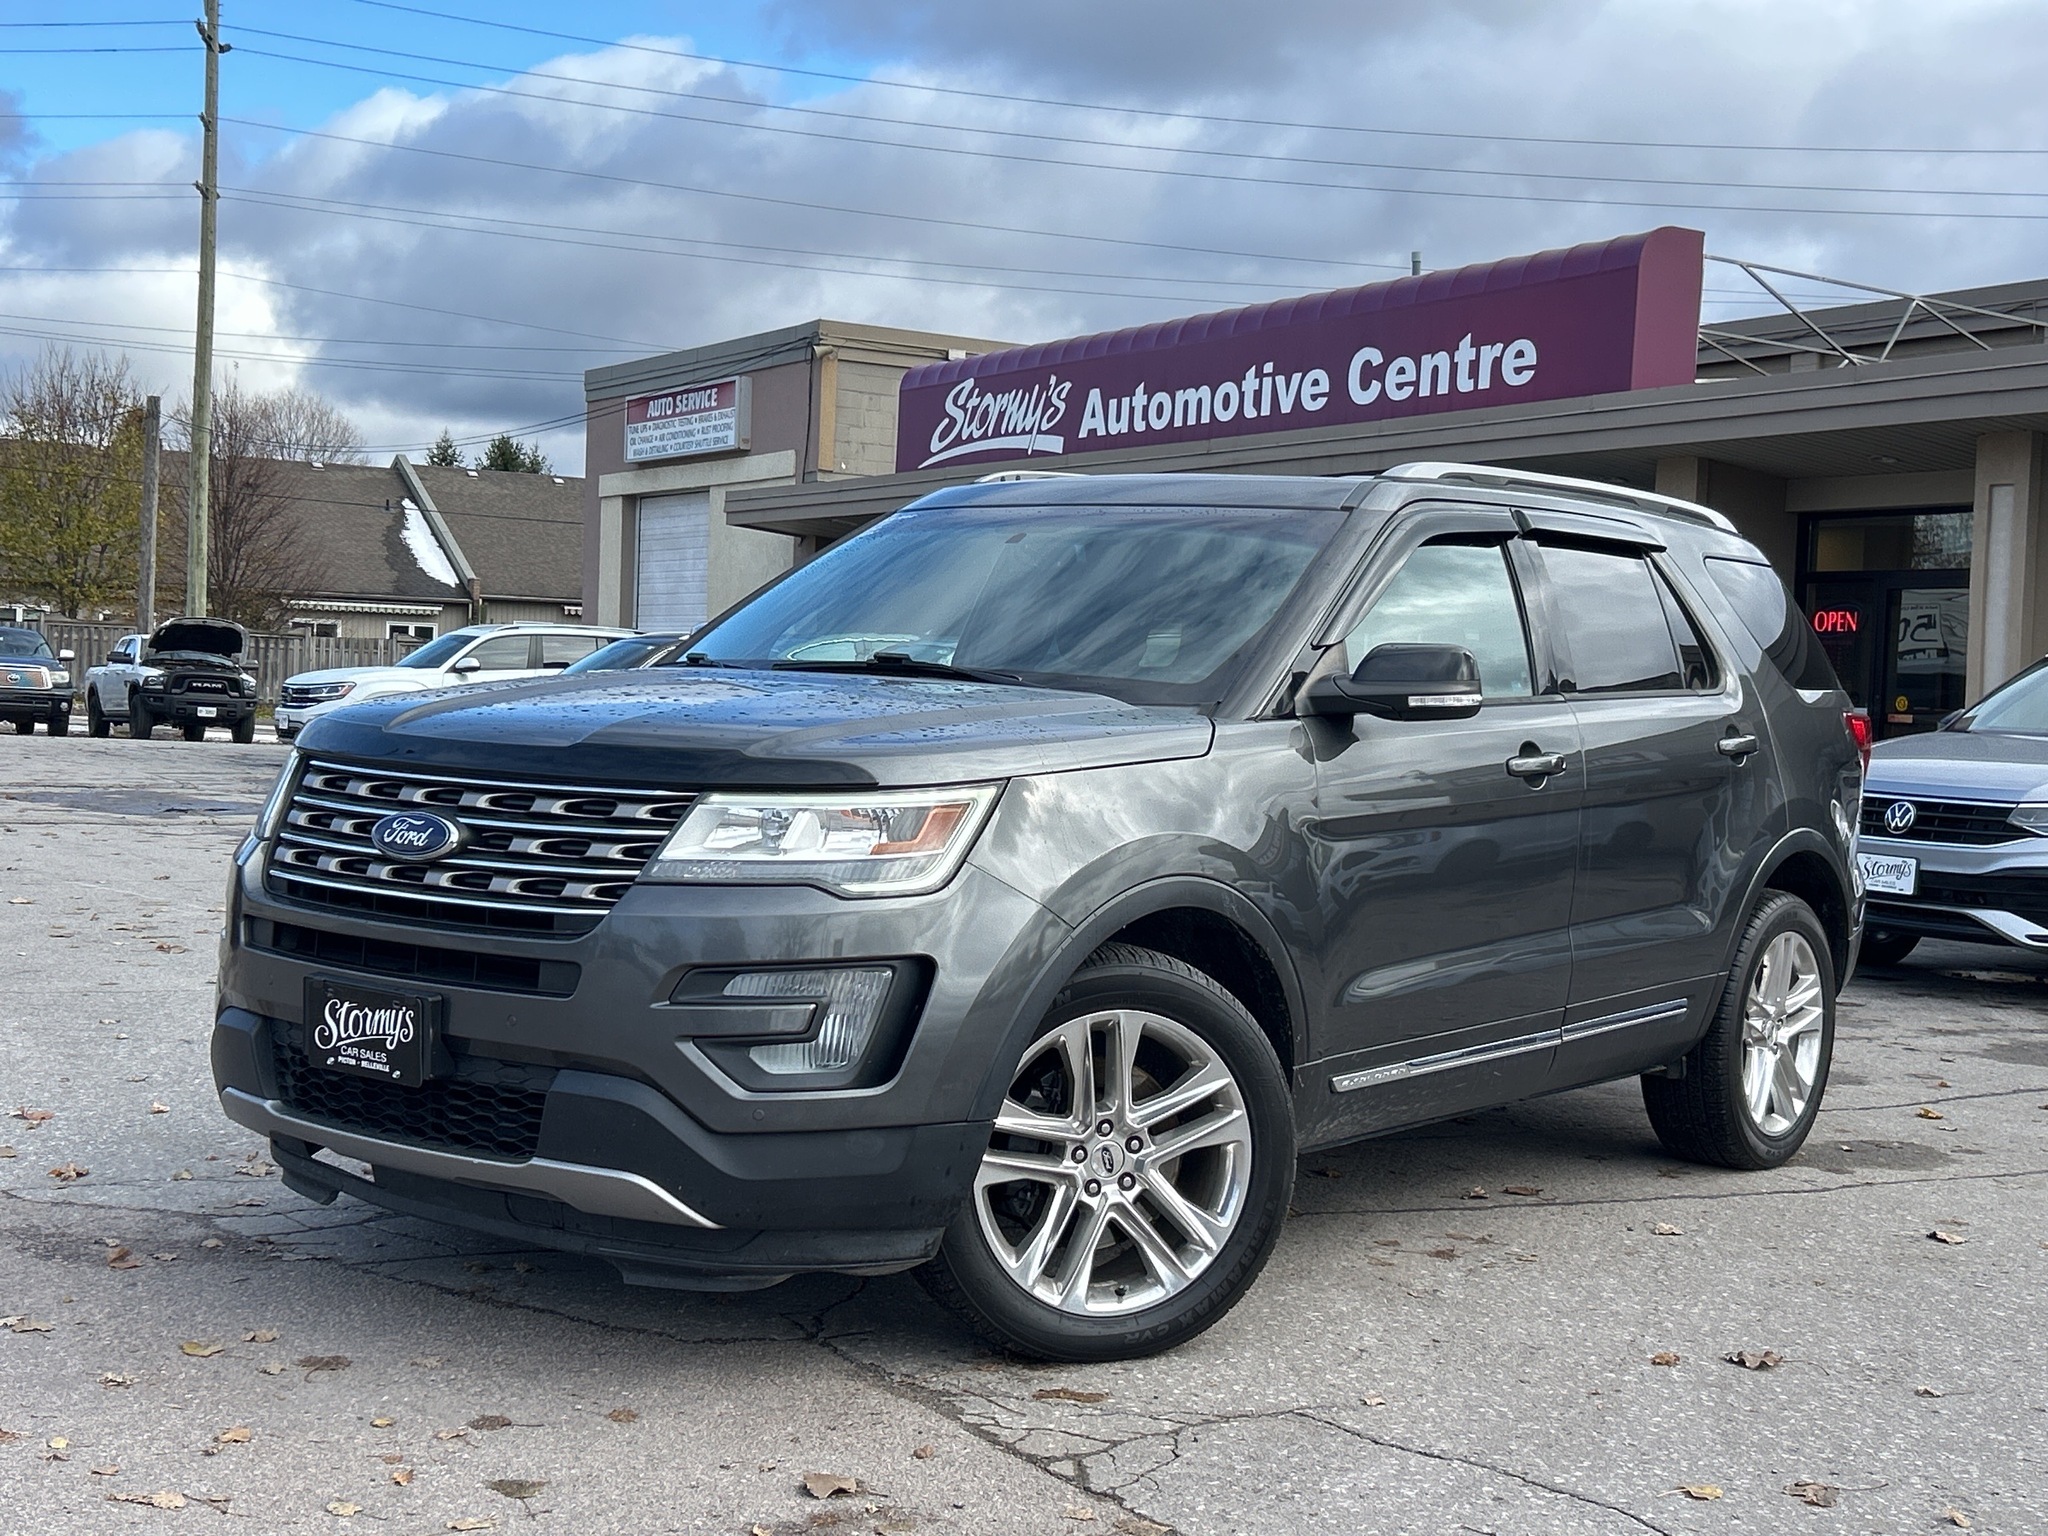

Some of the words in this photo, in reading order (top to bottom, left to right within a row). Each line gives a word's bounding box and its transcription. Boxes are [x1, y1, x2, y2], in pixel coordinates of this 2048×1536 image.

[647, 396, 673, 418] AUTO
[675, 387, 718, 414] SERVICE
[930, 374, 1073, 461] Stormy's
[1077, 361, 1329, 439] Automotive
[1346, 332, 1538, 406] Centre
[1814, 611, 1858, 632] OPEN
[383, 817, 434, 847] Ford
[1862, 860, 1913, 881] Stormy's
[314, 998, 415, 1050] Stormy's
[340, 1045, 359, 1058] CAR
[359, 1050, 387, 1063] SALES
[361, 1060, 390, 1072] BELLEVILLE
[1124, 1324, 1170, 1345] CVR
